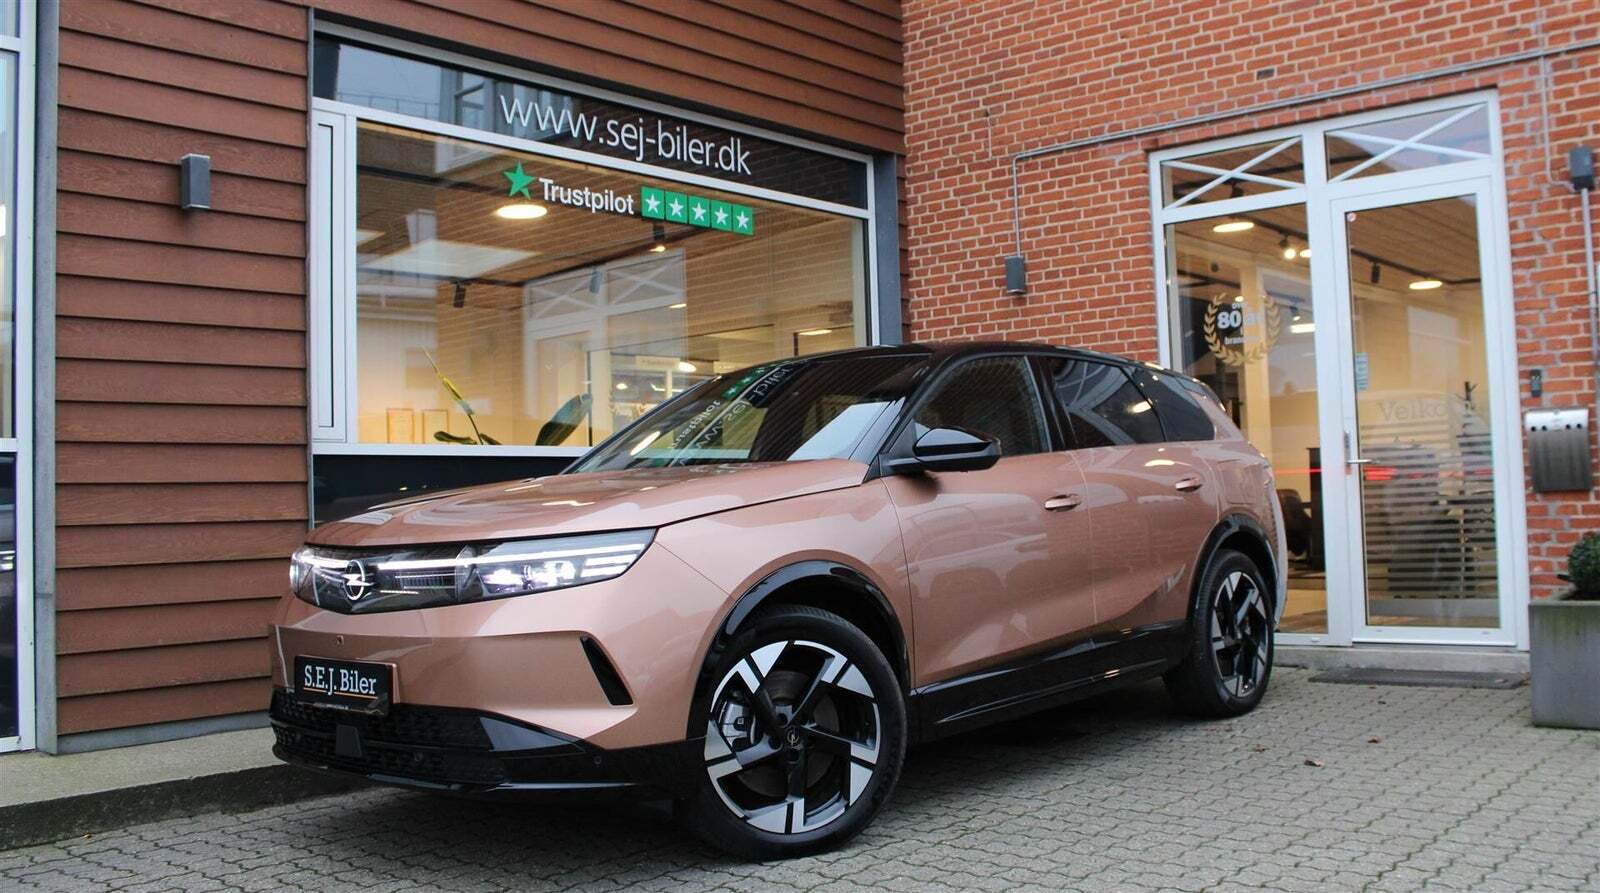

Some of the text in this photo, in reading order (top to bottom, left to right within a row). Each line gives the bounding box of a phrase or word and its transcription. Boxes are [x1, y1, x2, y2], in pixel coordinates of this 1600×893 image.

[500, 95, 751, 175] www.sej-biler.dk
[539, 177, 634, 215] Trustpilot
[1216, 310, 1242, 329] 80
[304, 664, 377, 696] S.E.J. Biler
